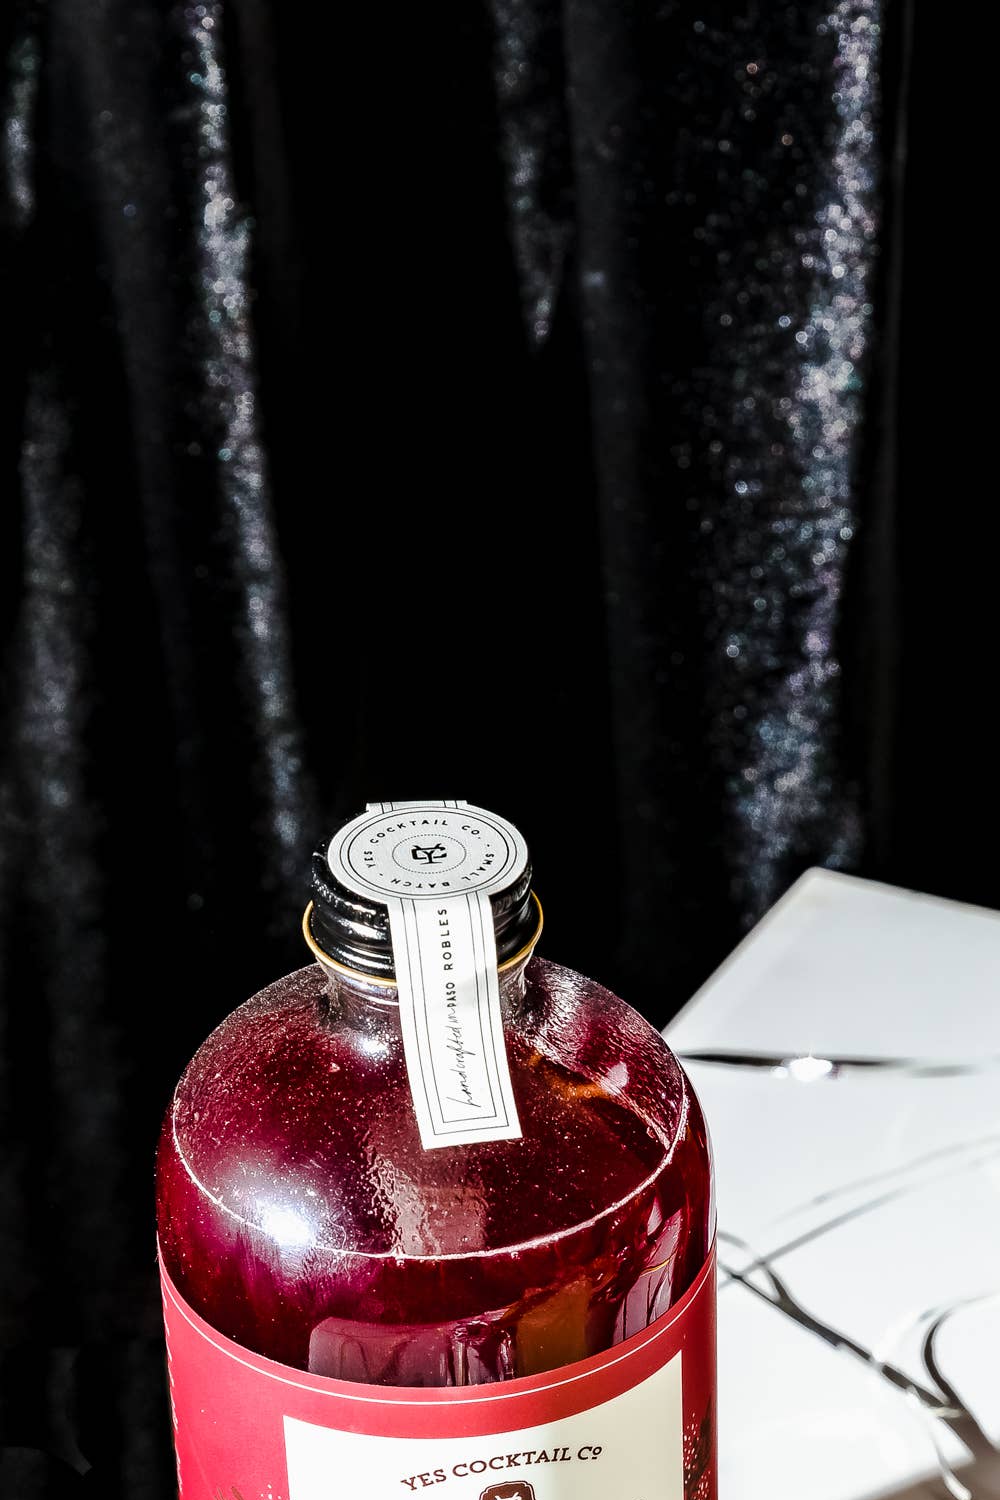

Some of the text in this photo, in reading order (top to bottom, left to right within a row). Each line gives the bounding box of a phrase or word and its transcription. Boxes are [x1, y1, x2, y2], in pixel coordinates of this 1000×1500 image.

[363, 850, 376, 869] YES
[370, 819, 448, 845] COCKTAIL
[390, 852, 495, 889] SMALL BATCH
[438, 908, 454, 971] ROBLES
[445, 982, 457, 1008] PASO
[400, 1469, 447, 1491] YES
[452, 1447, 572, 1478] COCKTAIL
